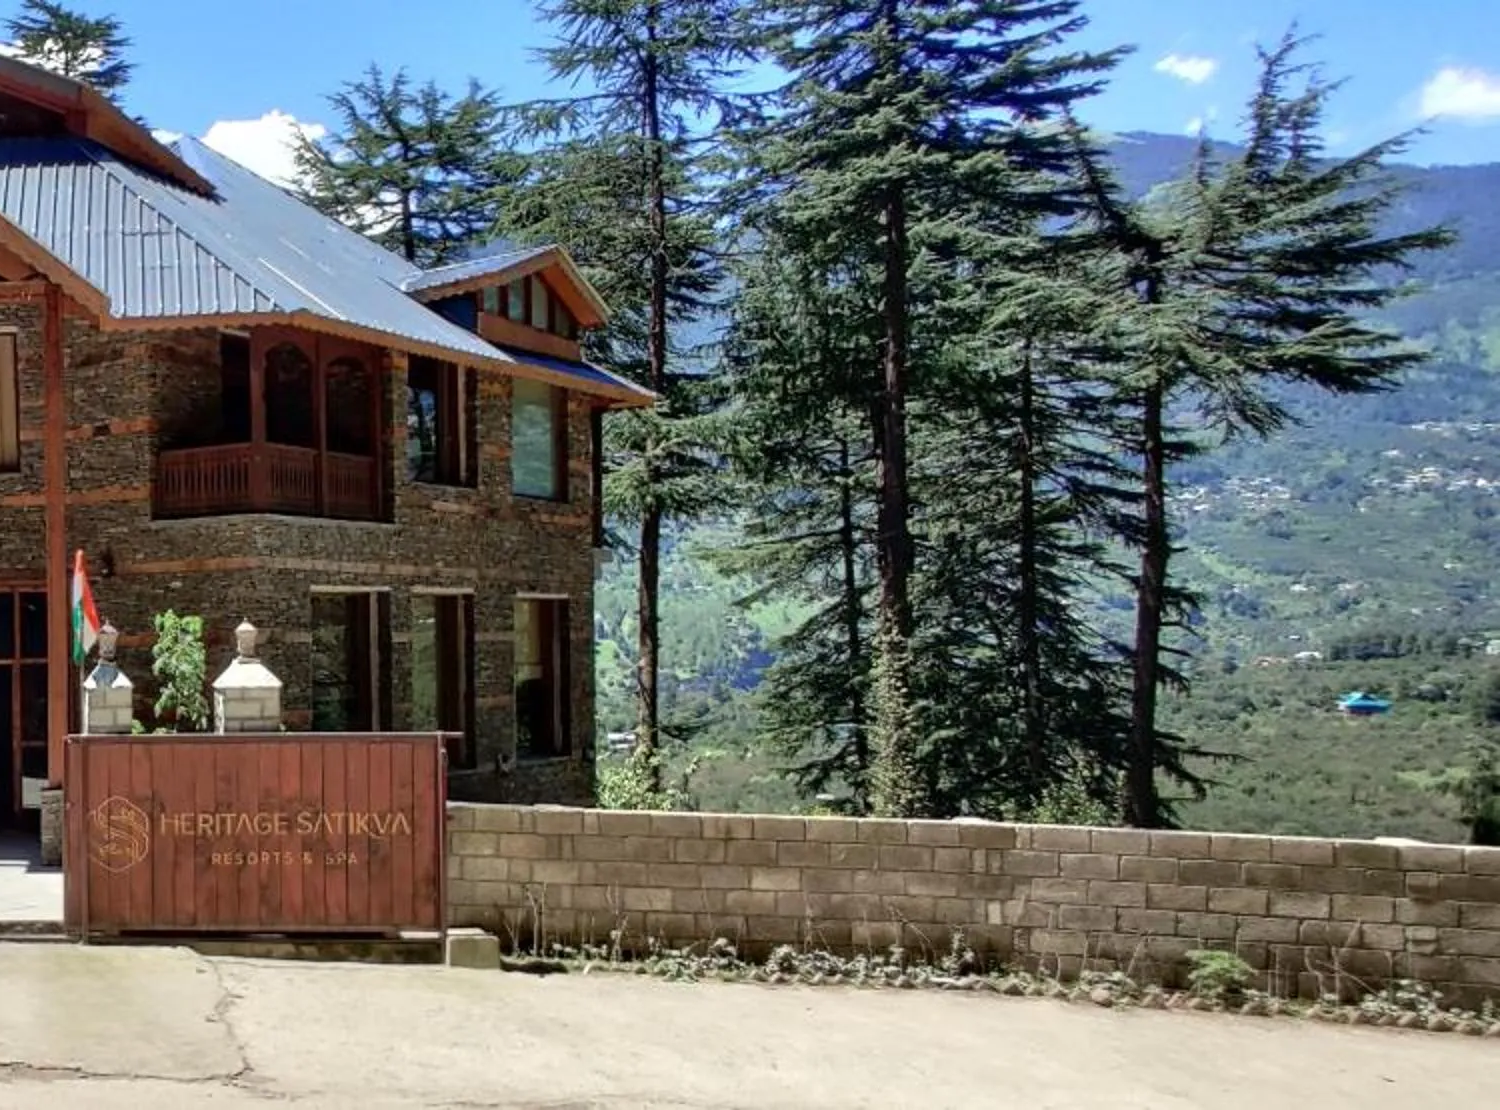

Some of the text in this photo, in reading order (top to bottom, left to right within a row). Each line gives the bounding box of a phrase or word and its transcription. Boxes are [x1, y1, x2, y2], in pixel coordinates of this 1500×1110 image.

[159, 811, 412, 840] HERITAGE SATIKVA
[211, 851, 359, 866] RESORTS & SPA
